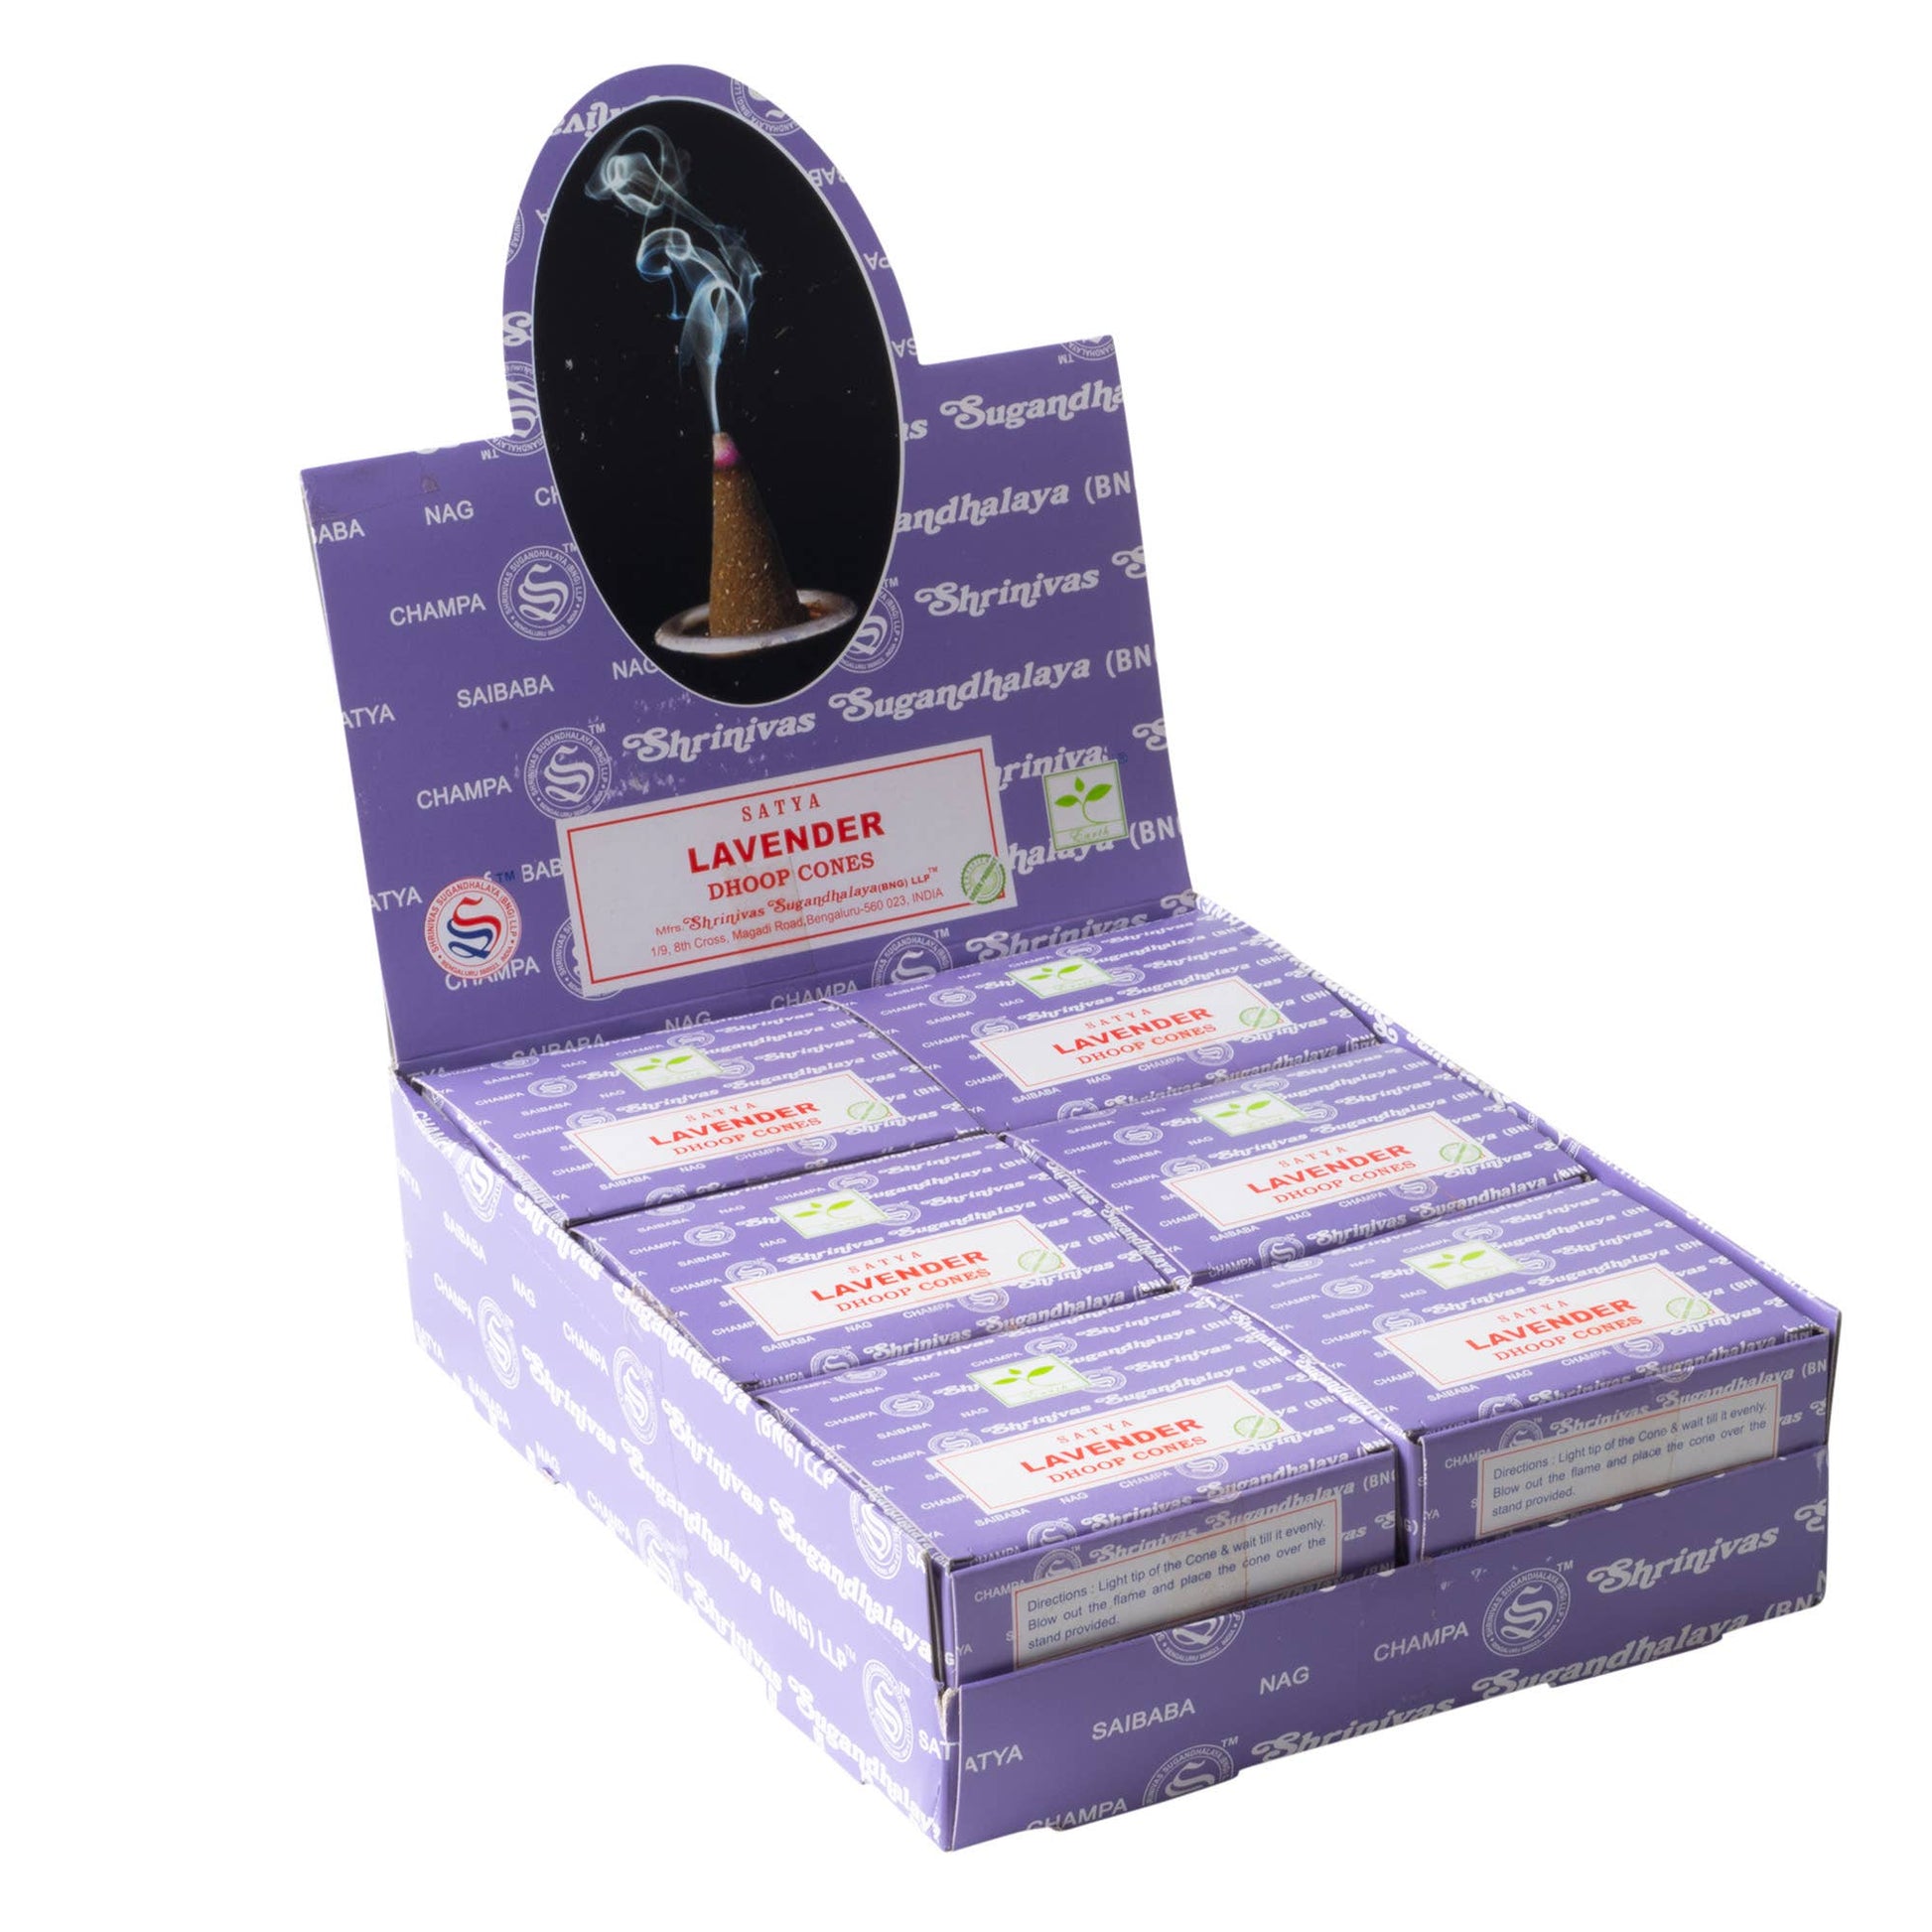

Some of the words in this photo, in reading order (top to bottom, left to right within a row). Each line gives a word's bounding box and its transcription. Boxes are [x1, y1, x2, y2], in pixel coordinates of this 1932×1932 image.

[425, 501, 475, 525] NAG
[894, 483, 1069, 535] andhalaya
[389, 594, 486, 626] CHAMPA
[914, 568, 1100, 617] Shrinivas
[457, 675, 554, 708] SAIBABA
[612, 657, 659, 680] NAG
[622, 713, 816, 762] Shrinivas
[828, 658, 1090, 722] Sugandhalaya
[417, 775, 512, 809] CHAMPA
[743, 793, 821, 822] SATYA
[687, 811, 885, 874] LAVENDER
[521, 859, 563, 883] BAB
[708, 870, 790, 900] DHOOP
[797, 852, 875, 882] CONES
[651, 943, 673, 957] 1/9,
[674, 939, 691, 953] 8th
[694, 933, 730, 949] Cross,
[733, 923, 772, 941] Magadi
[887, 896, 909, 909] 023,
[912, 889, 943, 903] INDIA
[683, 905, 765, 930] Shrinivas
[934, 928, 949, 938] TM
[1053, 1008, 1214, 1054] LAVENDER
[1084, 1009, 1152, 1030] SATYA
[1077, 1042, 1144, 1065] DHOOP
[1151, 1024, 1217, 1045] CONES
[649, 1102, 820, 1146] LAVENDER
[685, 1102, 757, 1122] SATYA
[673, 1134, 746, 1157] DHOOP
[753, 1117, 822, 1138] CONES
[1279, 1146, 1346, 1169] SATYA
[1247, 1145, 1412, 1194] LAVENDER
[1274, 1177, 1343, 1204] DHOOP
[1349, 1162, 1417, 1182] CONES
[1307, 1213, 1407, 1246] Shrinivas
[1410, 1176, 1547, 1219] Sugandhalaya
[810, 1250, 990, 1301] LAVENDER
[848, 1251, 922, 1273] SATYA
[511, 1274, 537, 1309] NAG
[837, 1287, 912, 1312] DHOOP
[918, 1269, 992, 1291] CONES
[1497, 1300, 1569, 1322] SATYA
[864, 1328, 971, 1361] Shrinivas
[976, 1290, 1125, 1334] Sugandhalaya
[1321, 1328, 1372, 1345] CHAMPA
[1464, 1299, 1636, 1351] LAVENDER
[1493, 1331, 1567, 1361] DHOOP
[1573, 1316, 1642, 1338] CONES
[563, 1321, 609, 1376] CHAMPA
[1561, 1348, 1610, 1366] CHAMPA
[522, 1345, 617, 1453] Shrinivas
[1095, 1365, 1247, 1405] Sugandhalaya
[1427, 1383, 1479, 1402] SAIBABA
[1021, 1419, 1203, 1473] LAVENDER
[1056, 1420, 1133, 1444] SATYA
[1493, 1456, 1548, 1479] Directions
[1559, 1446, 1586, 1464] Light
[1587, 1442, 1601, 1458] tip
[1604, 1438, 1616, 1451] of
[1618, 1433, 1635, 1447] the
[1638, 1425, 1668, 1443] Cone
[1670, 1421, 1679, 1433] &
[1681, 1416, 1704, 1432] wait
[1706, 1410, 1719, 1426] till
[1721, 1409, 1728, 1422] it
[1729, 1400, 1767, 1421] evenly.
[1048, 1456, 1126, 1483] DHOOP
[1133, 1437, 1207, 1461] CONES
[1493, 1478, 1520, 1499] Blow
[1525, 1476, 1543, 1490] out
[1548, 1469, 1566, 1483] the
[1571, 1461, 1600, 1477] flame
[1605, 1452, 1626, 1468] and
[1631, 1444, 1662, 1464] place
[1667, 1438, 1684, 1451] the
[1689, 1433, 1716, 1447] cone
[1721, 1425, 1744, 1440] over
[1749, 1417, 1767, 1432] the
[1060, 1493, 1088, 1504] NAG
[1119, 1470, 1172, 1489] CHAMPA
[1491, 1501, 1523, 1517] stand
[1525, 1486, 1577, 1510] provided.
[621, 1438, 762, 1594] Sugandhalaya
[661, 1399, 763, 1514] Shrinivas
[769, 1497, 932, 1665] Sugandhalaya
[974, 1508, 1031, 1527] SAIBABA
[1028, 1587, 1087, 1612] Directions
[1098, 1575, 1127, 1595] Light
[1131, 1570, 1147, 1588] tip
[1149, 1565, 1163, 1581] of
[1164, 1559, 1182, 1574] the
[1185, 1549, 1217, 1569] Cone
[1220, 1545, 1230, 1557] &
[1232, 1536, 1256, 1555] wait
[1257, 1529, 1272, 1548] till
[1275, 1529, 1284, 1544] it
[1285, 1519, 1325, 1542] evenly.
[1557, 1560, 1574, 1573] TM
[1587, 1527, 1779, 1593] Shrinivas
[1028, 1612, 1057, 1631] Blow
[1063, 1606, 1082, 1620] out
[1088, 1598, 1107, 1614] the
[1113, 1589, 1147, 1608] flame
[1152, 1580, 1175, 1595] and
[1180, 1569, 1212, 1591] place
[1217, 1562, 1236, 1578] the
[1242, 1554, 1271, 1571] cone
[1276, 1547, 1304, 1561] over
[1308, 1536, 1326, 1551] the
[1028, 1631, 1061, 1649] stand
[1064, 1615, 1121, 1642] provided.
[1260, 1666, 1311, 1695] NAG
[1373, 1621, 1468, 1662] CHAMPA
[1472, 1611, 1748, 1701] Sugandhalaya
[1091, 1698, 1195, 1741] SAIBABA
[1220, 1736, 1239, 1747] TM
